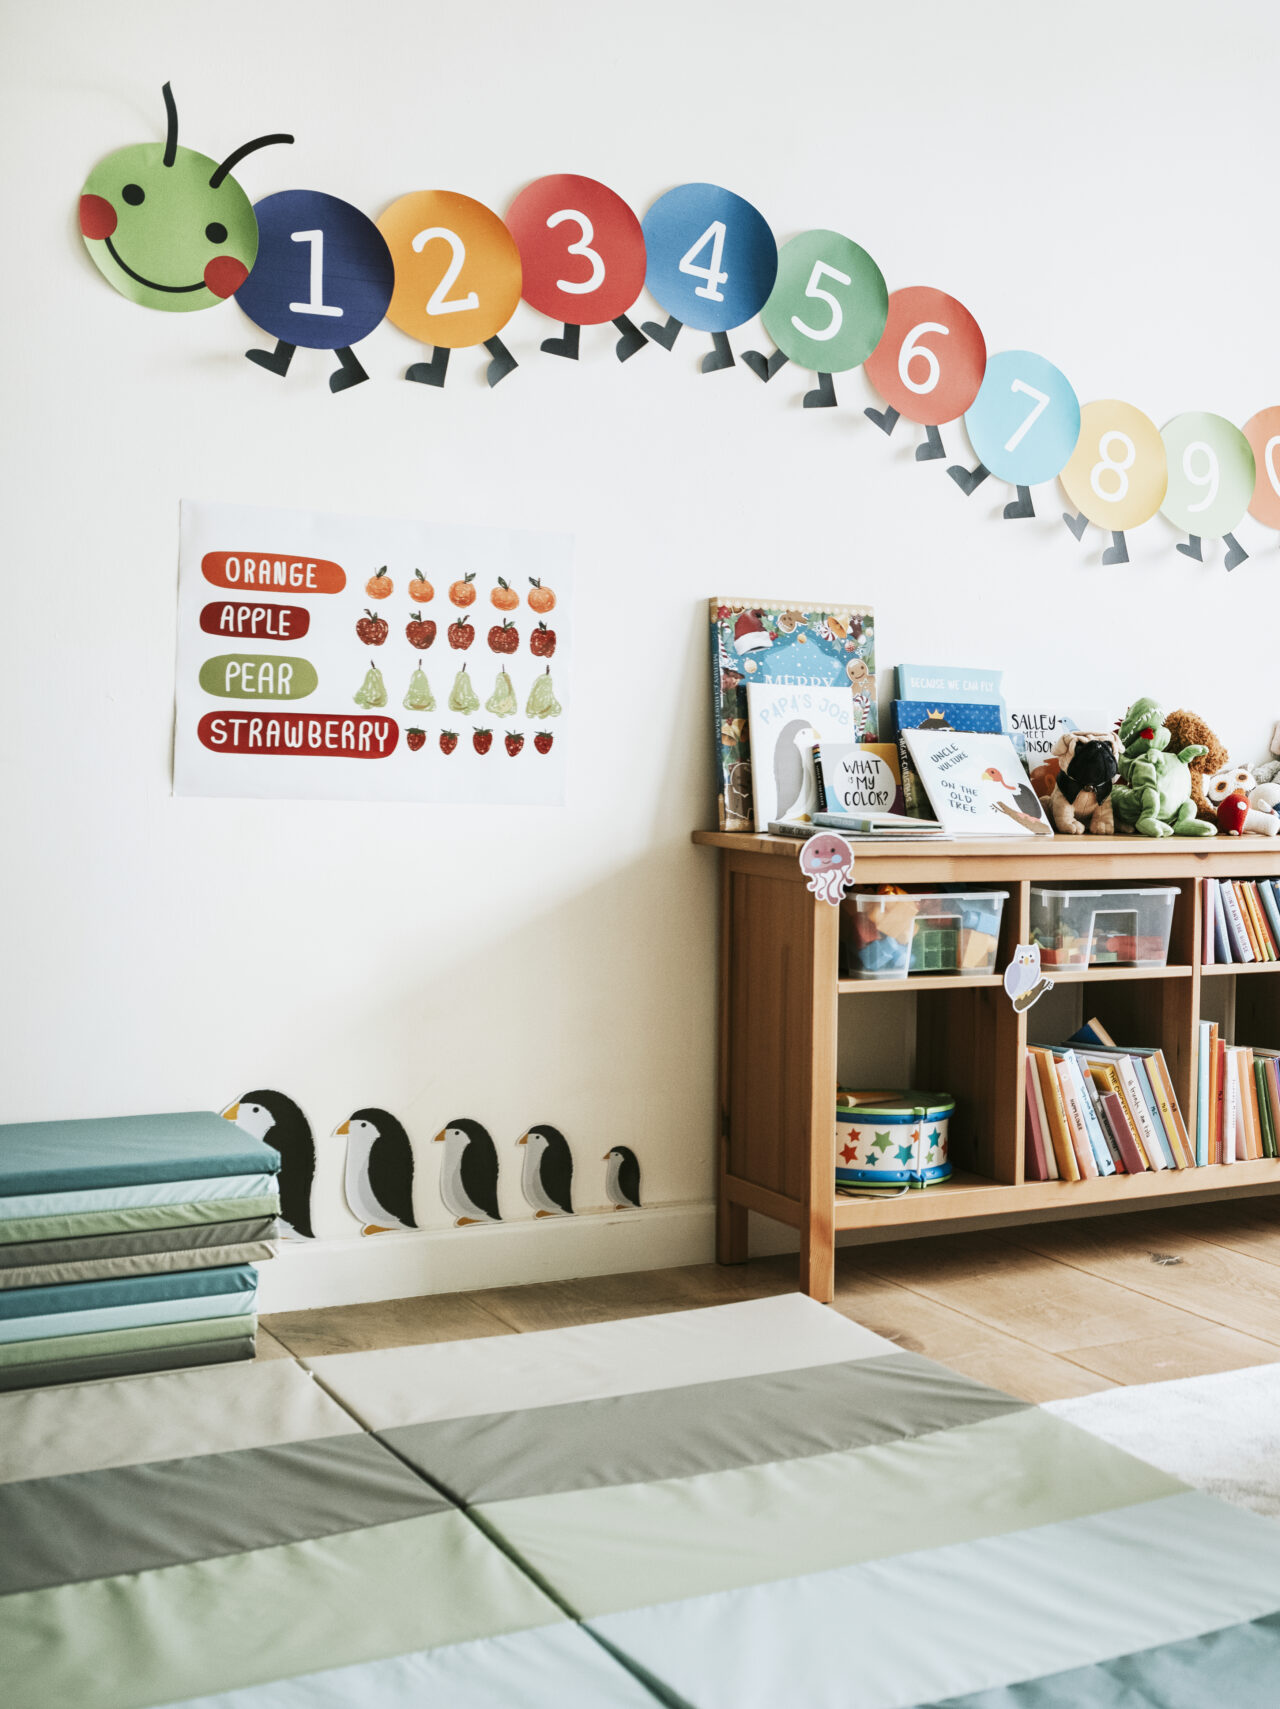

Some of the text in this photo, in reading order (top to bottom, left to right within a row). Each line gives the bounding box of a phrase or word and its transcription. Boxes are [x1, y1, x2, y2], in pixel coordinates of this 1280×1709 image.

[289, 230, 343, 317] 1
[412, 227, 479, 315] 2
[547, 209, 605, 294] 3
[678, 220, 728, 302] 4
[791, 260, 851, 341] 5
[897, 321, 950, 394] 6
[1004, 379, 1050, 452] 7
[1090, 430, 1136, 502] 8
[1182, 441, 1219, 513] 9
[225, 556, 318, 589] ORANGE
[220, 605, 291, 637] APPLE
[225, 661, 293, 695] PEAR
[910, 677, 945, 689] BECAUSE
[948, 679, 960, 690] WE
[980, 681, 994, 692] FLY
[760, 693, 849, 725] PAPA'S JOB
[1011, 713, 1056, 731] SALLEY
[210, 718, 389, 753] STRAWBERRY
[1022, 730, 1045, 739] MEET
[931, 743, 959, 763] UNCLE
[937, 751, 968, 772] VULTURE
[842, 759, 881, 774] WHAT
[941, 780, 978, 797] ON THE
[950, 791, 973, 803] OLD
[844, 791, 889, 806] COLOR?
[949, 799, 977, 814] TREE
